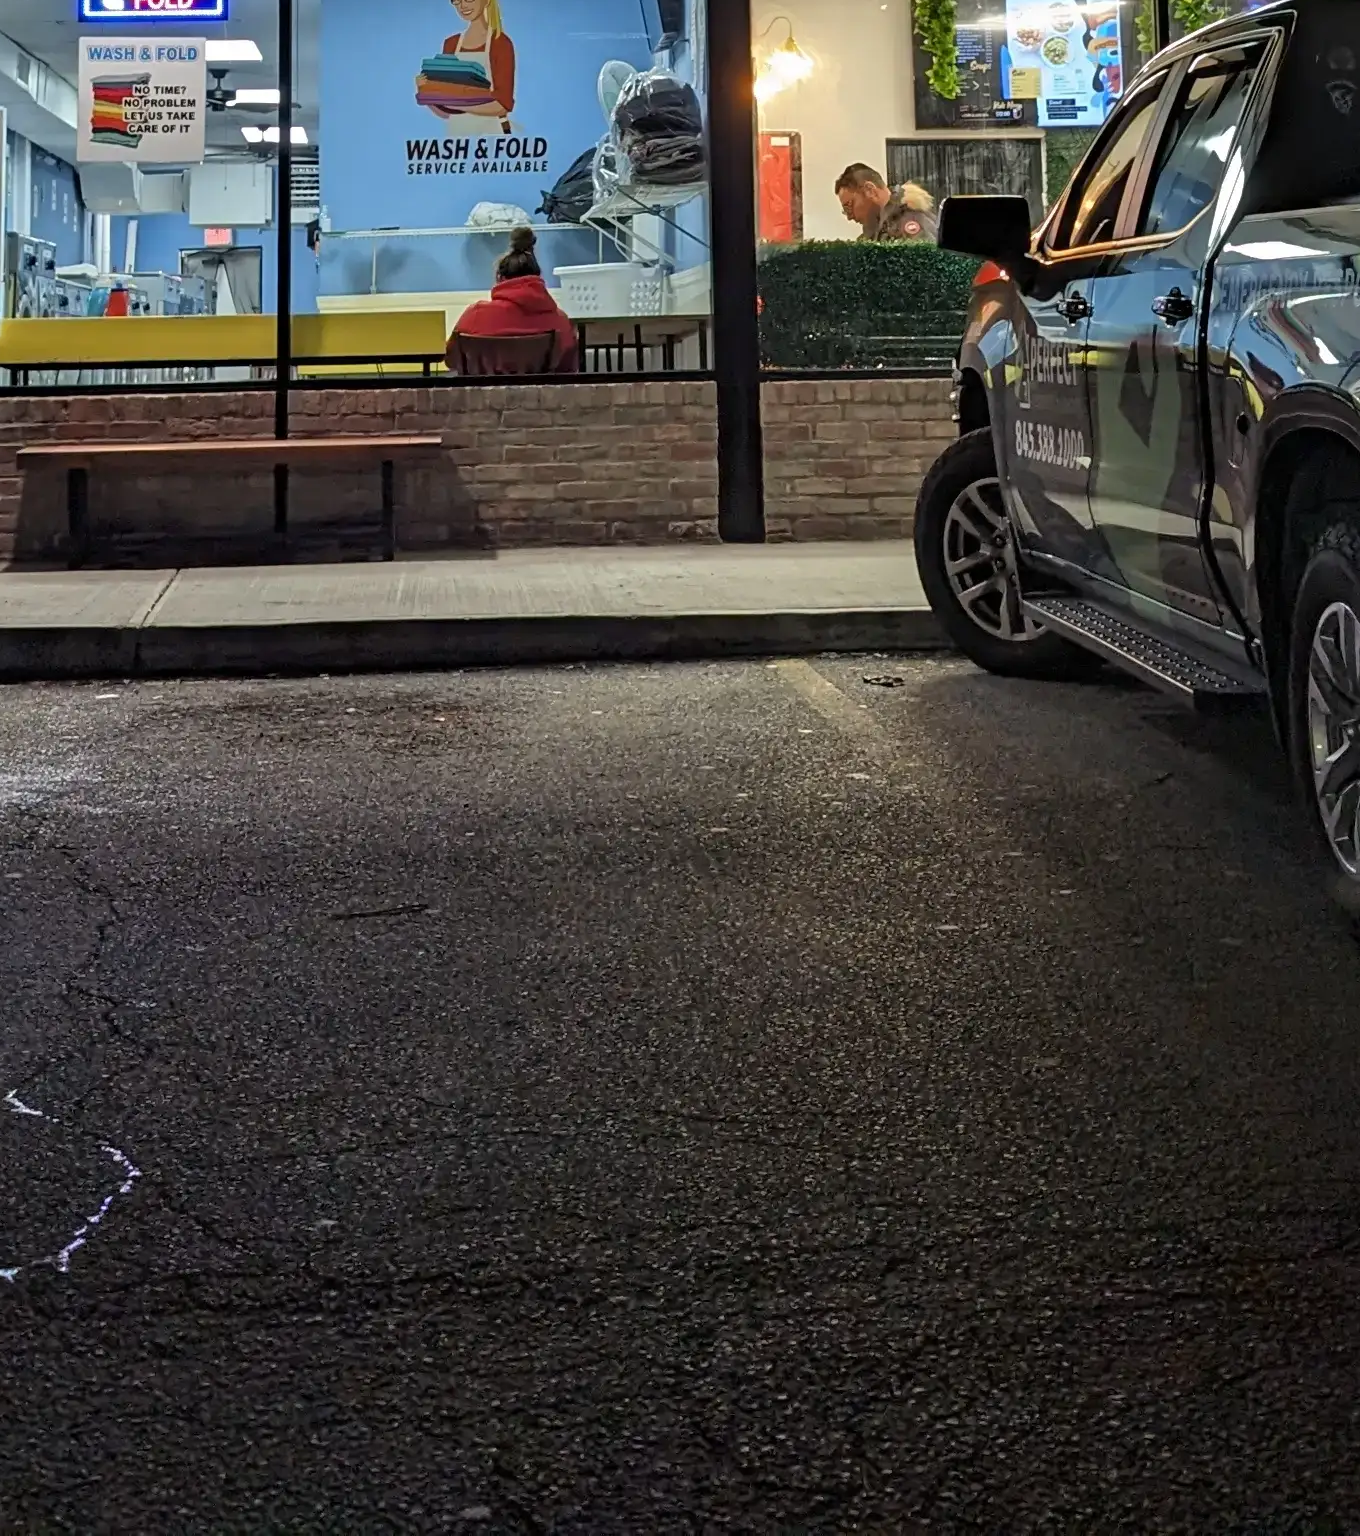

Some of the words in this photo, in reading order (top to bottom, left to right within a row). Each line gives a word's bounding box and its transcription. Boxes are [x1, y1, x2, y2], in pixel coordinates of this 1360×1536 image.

[87, 46, 135, 61] WASH
[140, 46, 151, 61] &
[157, 46, 198, 61] FOLD
[134, 86, 151, 95] NO
[155, 86, 187, 95] TIME?
[124, 99, 141, 108] NO
[143, 99, 196, 108] PROBLEM
[124, 112, 143, 121] LET
[147, 112, 163, 121] US
[167, 112, 195, 121] TAKE
[128, 125, 157, 134] CARE
[161, 125, 176, 134] OF
[179, 124, 190, 133] IT
[406, 139, 469, 161] WASH
[474, 138, 489, 159] &
[494, 137, 548, 158] FOLD
[407, 163, 466, 175] SERVICE
[471, 160, 548, 174] AVAILABLE
[1030, 336, 1078, 386] PERFECT
[1015, 419, 1086, 471] 845.388.1000
